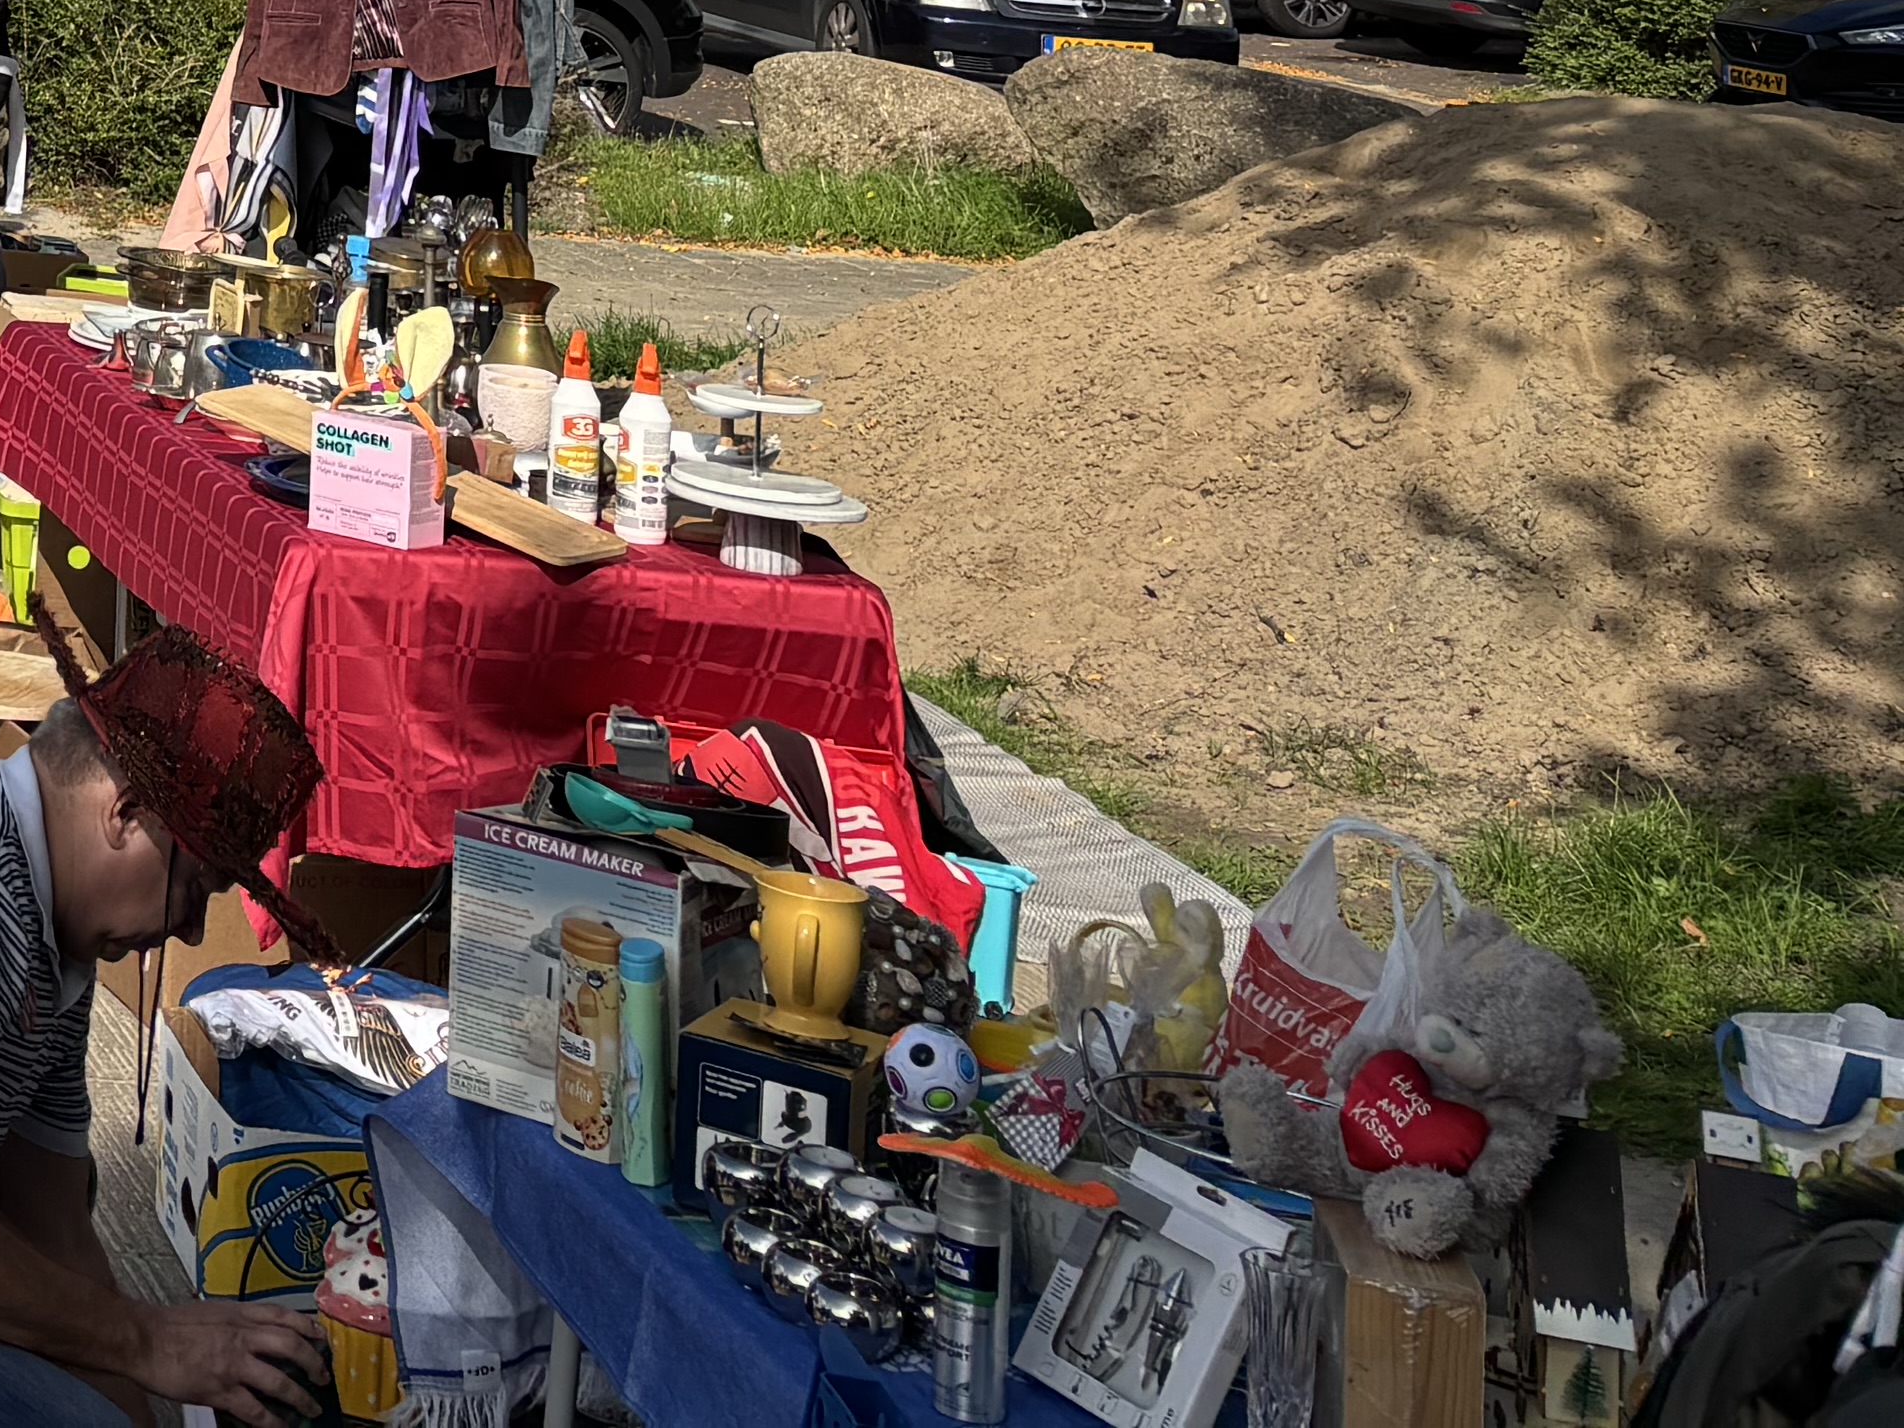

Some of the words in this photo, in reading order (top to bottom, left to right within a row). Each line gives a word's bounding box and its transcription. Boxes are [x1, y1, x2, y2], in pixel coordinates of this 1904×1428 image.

[316, 422, 390, 449] COLLAGEN
[572, 418, 593, 436] 3G
[316, 437, 353, 456] SHOT
[484, 823, 511, 845] ICE
[515, 831, 576, 860] CREAM
[582, 845, 645, 877] MAKER
